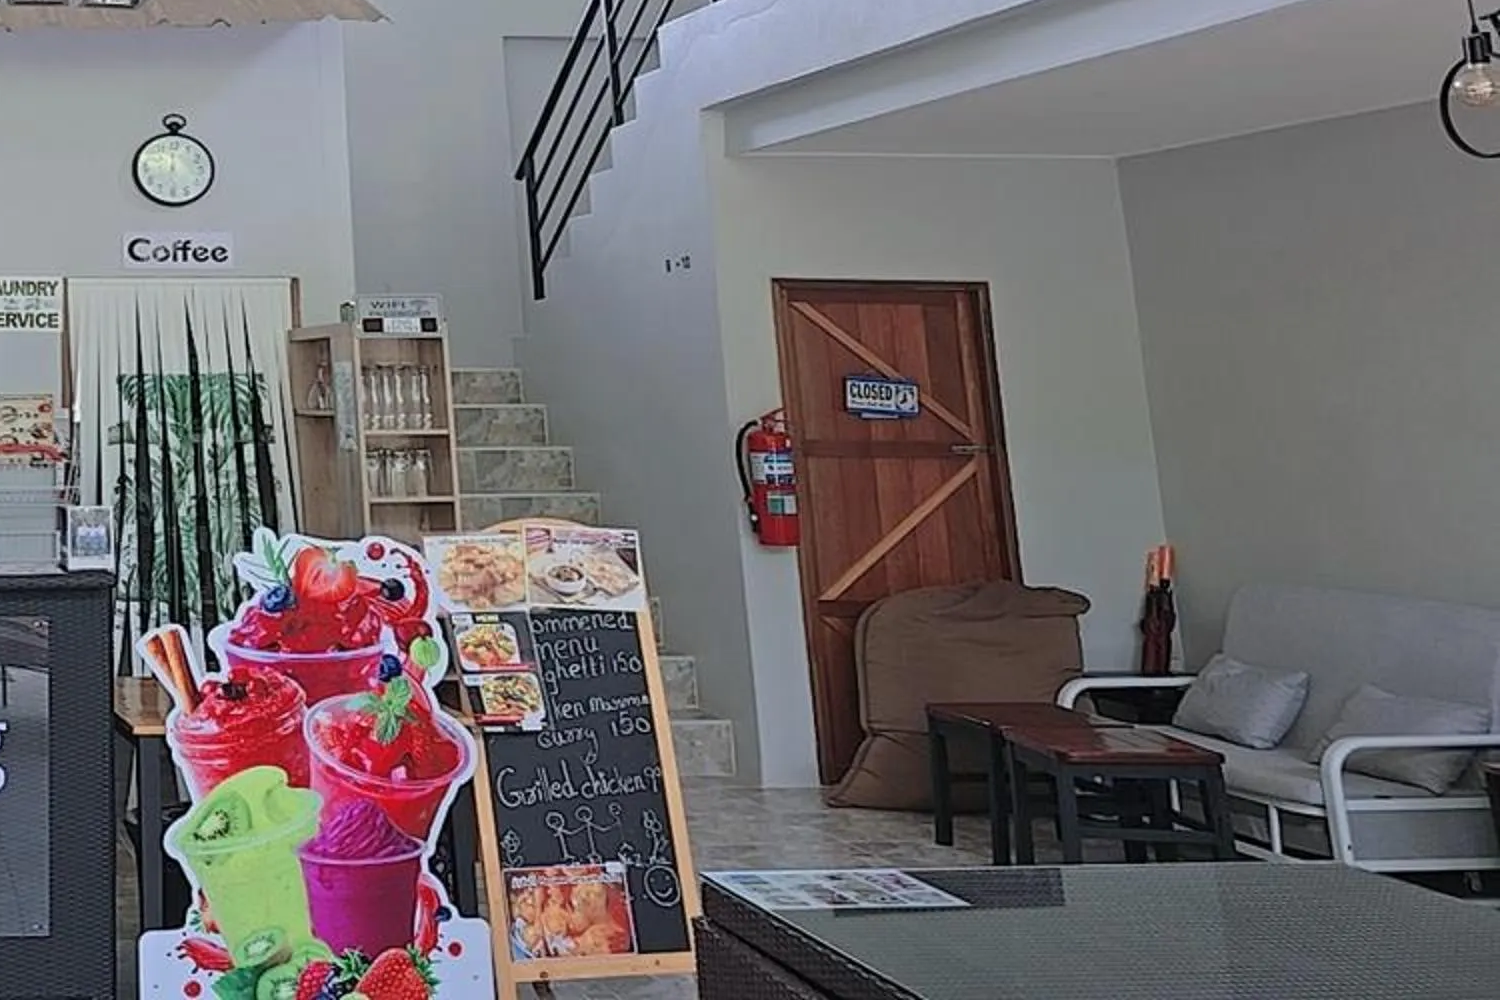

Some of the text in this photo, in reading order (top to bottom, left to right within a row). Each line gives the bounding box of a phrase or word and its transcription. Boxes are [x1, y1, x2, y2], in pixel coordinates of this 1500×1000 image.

[127, 237, 229, 263] Coffee
[849, 382, 893, 401] CLOSED
[531, 611, 634, 633] ommened
[612, 650, 643, 674] 150
[610, 711, 652, 737] 150
